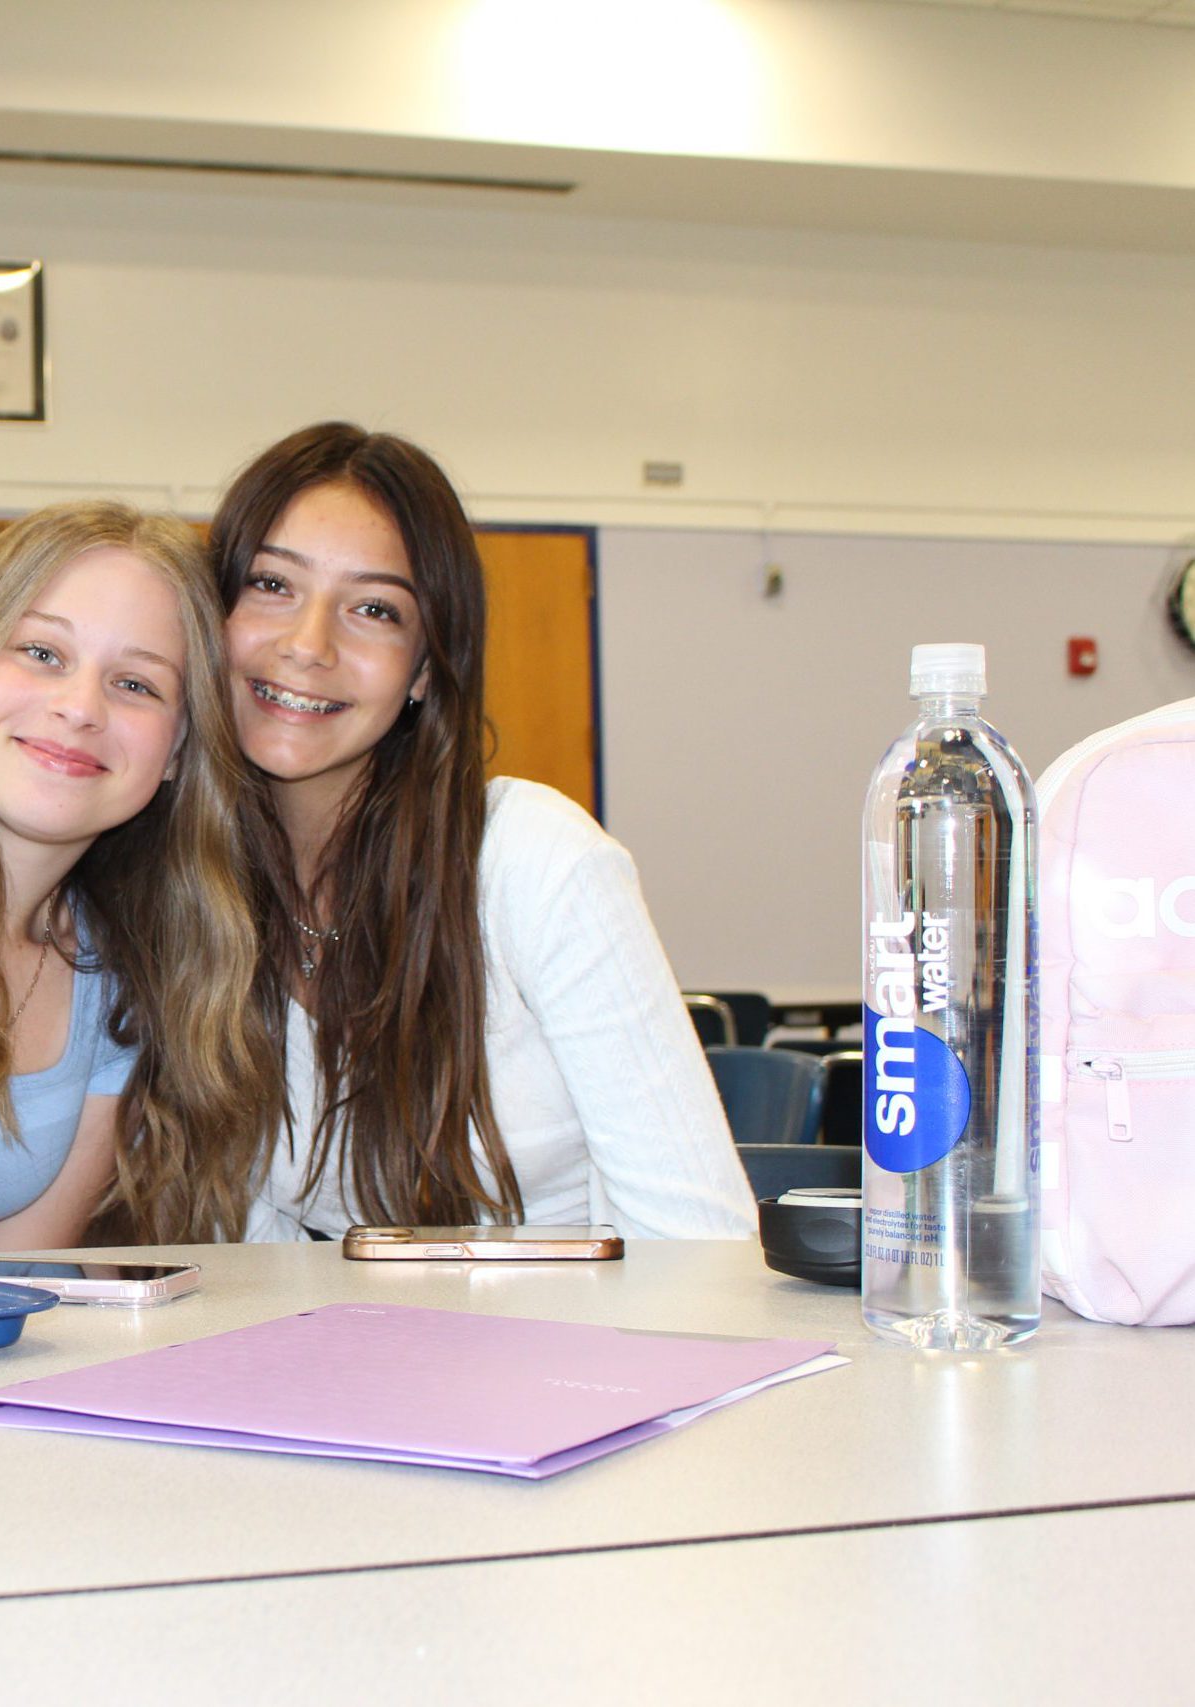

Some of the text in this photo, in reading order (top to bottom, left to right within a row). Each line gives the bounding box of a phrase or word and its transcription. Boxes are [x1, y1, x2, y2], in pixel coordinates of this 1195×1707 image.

[917, 911, 950, 1013] water
[869, 911, 916, 1137] smart
[883, 1209, 910, 1220] distilled
[912, 1213, 937, 1222] water
[910, 1221, 922, 1231] for
[885, 1230, 922, 1241] balanced
[924, 1233, 939, 1244] pH
